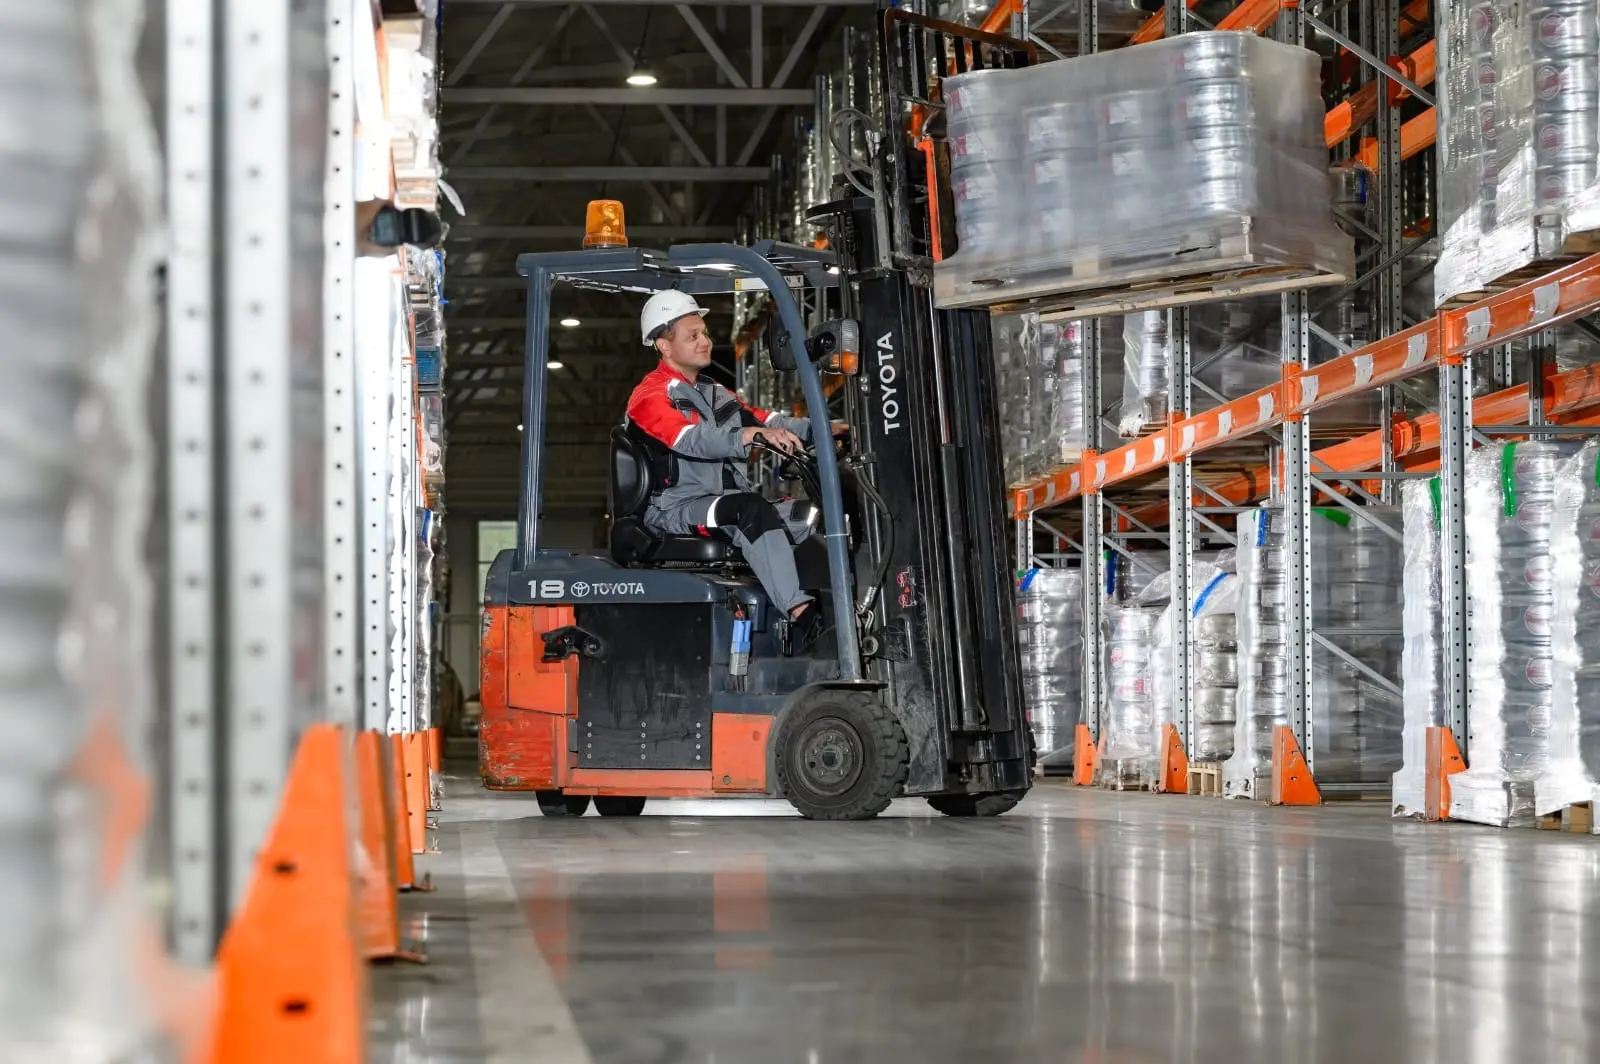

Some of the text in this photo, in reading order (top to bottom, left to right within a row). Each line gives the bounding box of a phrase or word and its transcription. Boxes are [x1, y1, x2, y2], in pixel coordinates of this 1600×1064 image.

[877, 331, 900, 435] TOYOTA
[528, 580, 645, 598] 18 TOYOTA
